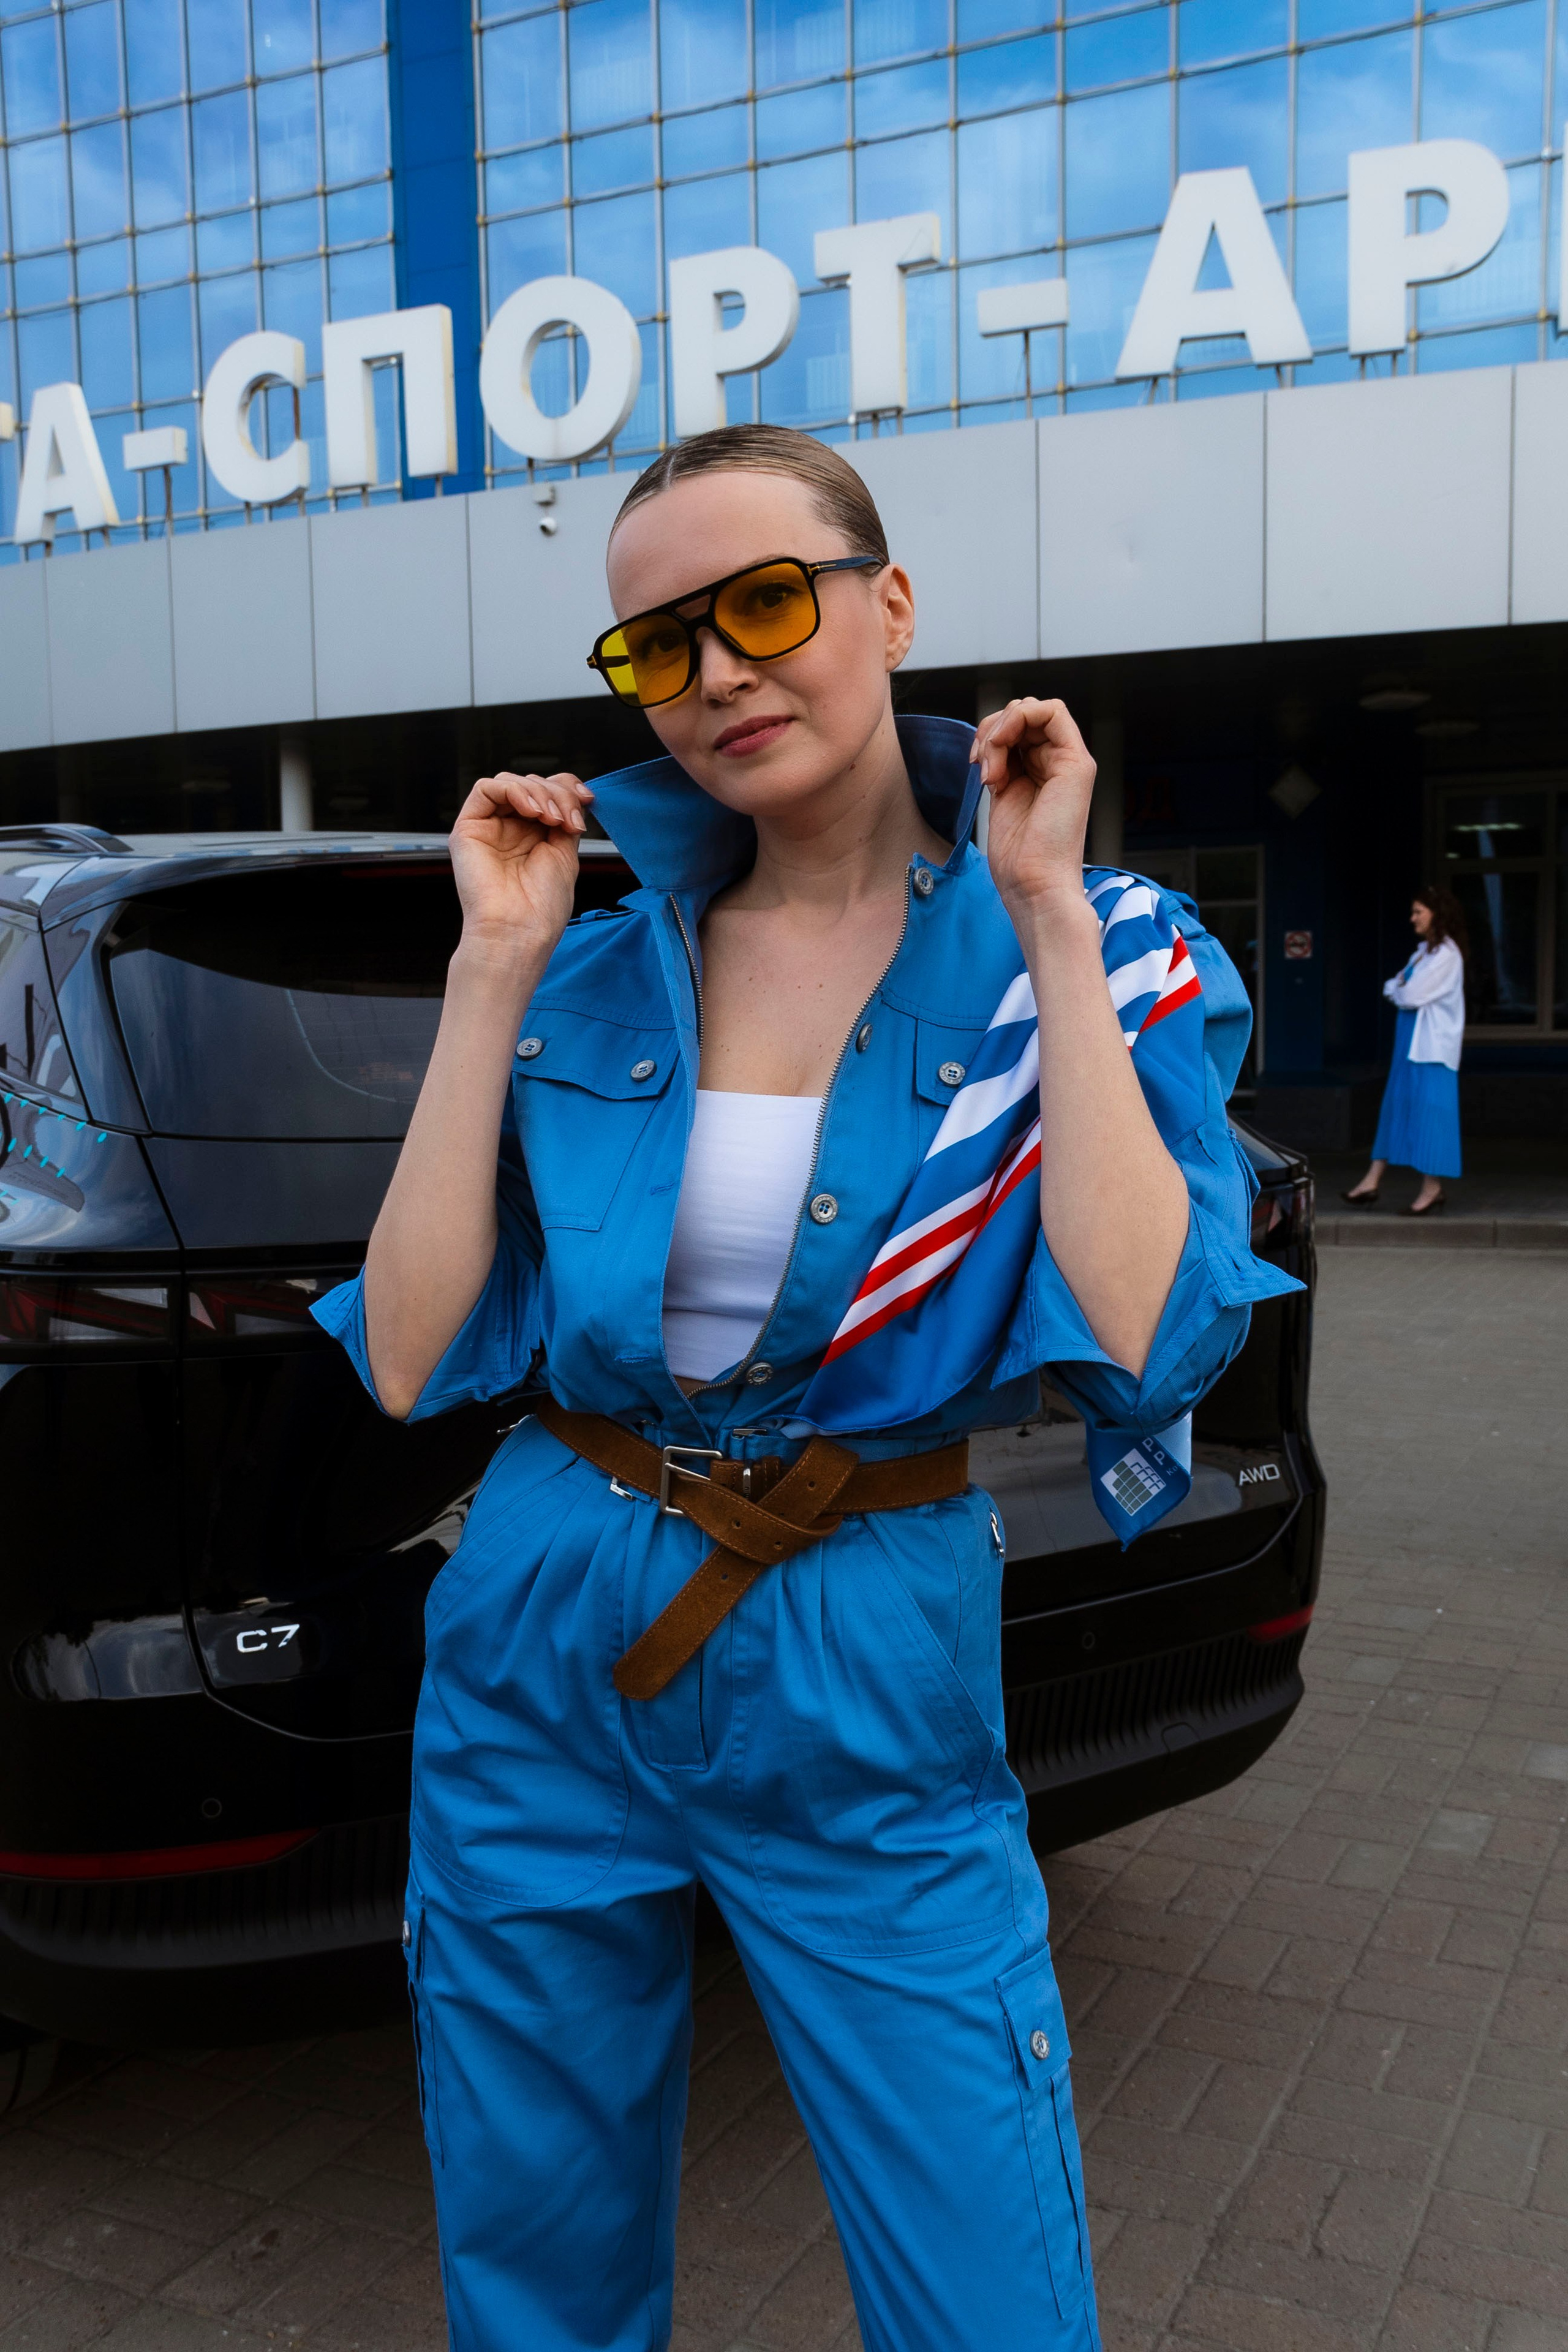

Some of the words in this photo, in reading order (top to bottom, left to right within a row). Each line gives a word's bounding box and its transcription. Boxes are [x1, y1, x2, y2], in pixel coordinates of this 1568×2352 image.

[0, 121, 1568, 545] А-СПОРТ-АР
[1239, 1463, 1280, 1487] AWD
[236, 1624, 300, 1653] C7
